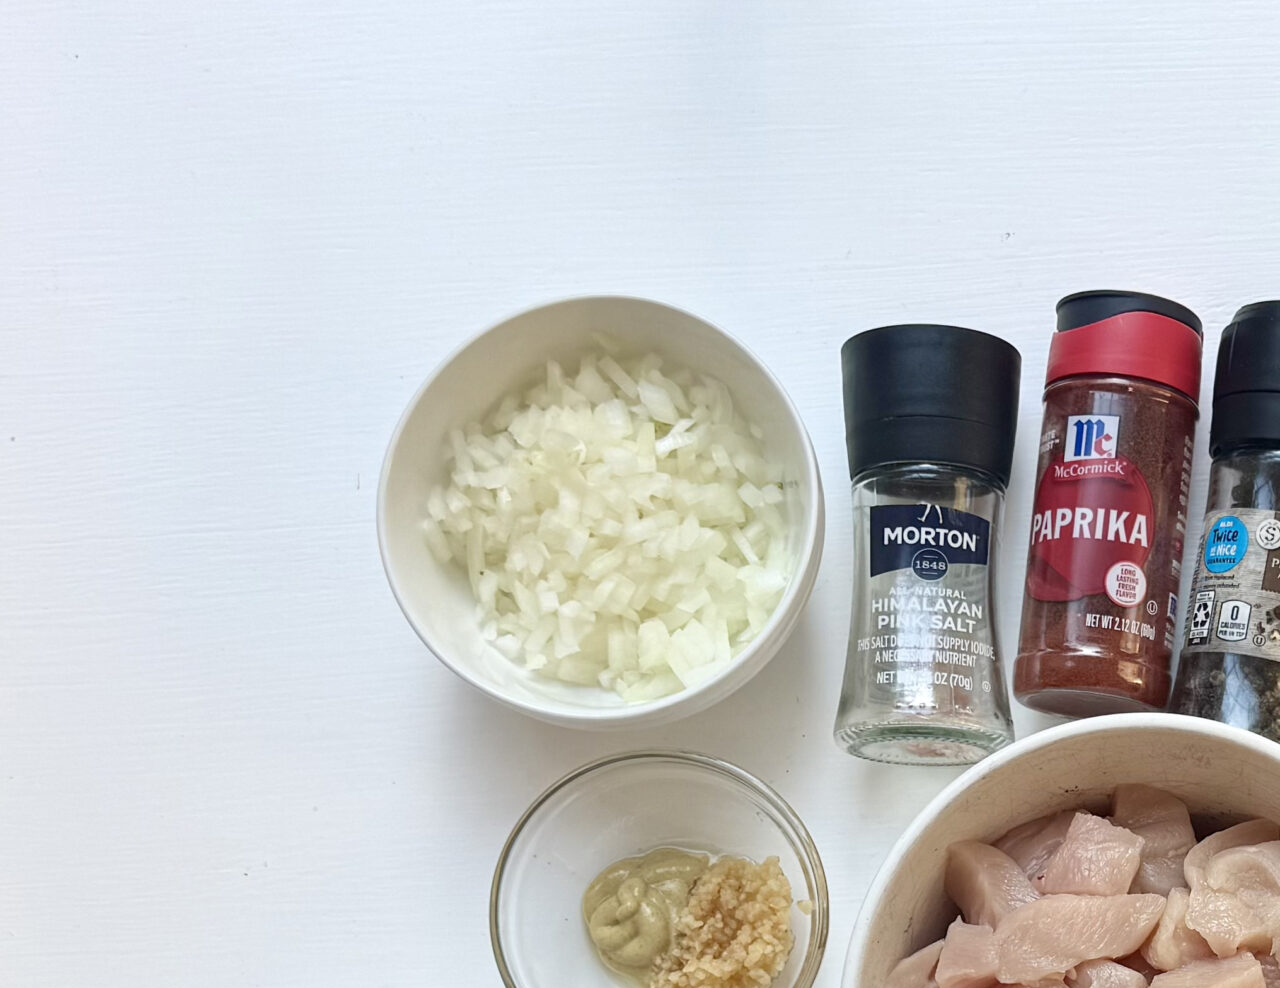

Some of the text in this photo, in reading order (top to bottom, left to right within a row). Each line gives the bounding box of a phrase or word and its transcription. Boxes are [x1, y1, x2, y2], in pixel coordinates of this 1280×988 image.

[1054, 460, 1125, 478] McCormick
[1031, 507, 1148, 548] PAPRIKA
[884, 526, 977, 552] MORTON
[915, 560, 946, 570] 1848
[1121, 568, 1136, 577] LONG
[1116, 574, 1139, 585] LASTING
[1118, 582, 1136, 591] FRESH
[872, 597, 982, 619] HIMALAYAN
[1231, 605, 1239, 621] 0
[878, 614, 976, 633] PINK SALT
[1086, 613, 1099, 627] NET
[1101, 615, 1113, 629] WT
[1114, 617, 1130, 632] 2.12
[1130, 619, 1140, 635] OZ
[1221, 622, 1246, 630] CALORIES
[871, 635, 889, 649] SALT
[938, 636, 970, 651] SUPPLY
[935, 651, 976, 667] NUTRIENT
[876, 671, 895, 683] NET
[934, 672, 947, 684] OZ
[949, 673, 973, 690] (70g)
